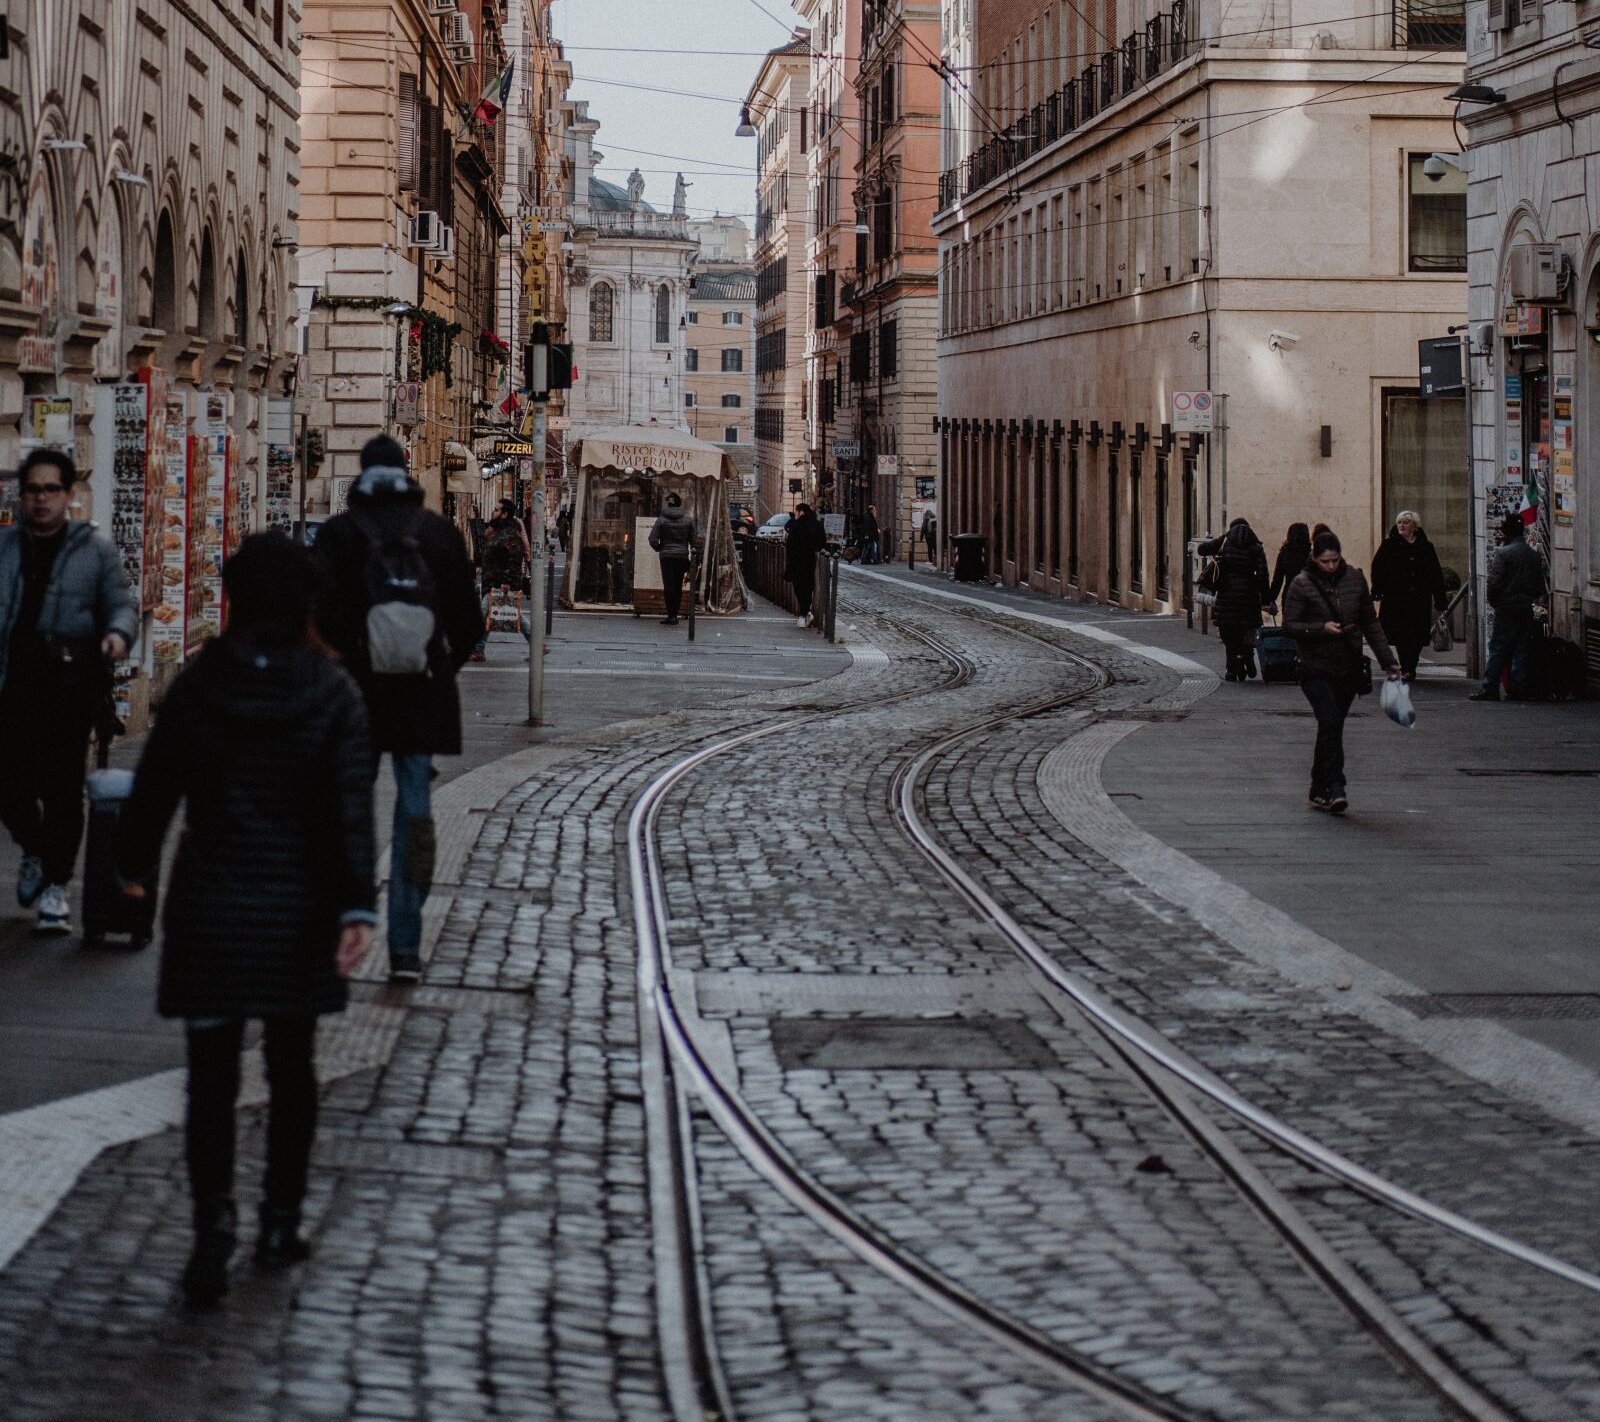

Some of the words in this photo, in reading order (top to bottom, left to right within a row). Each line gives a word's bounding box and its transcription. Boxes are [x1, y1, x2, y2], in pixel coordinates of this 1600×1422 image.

[519, 205, 568, 219] HOTEL
[496, 442, 534, 455] PIZZERI
[611, 443, 694, 462] RISTORANTE
[616, 454, 686, 471] IMPERIUM
